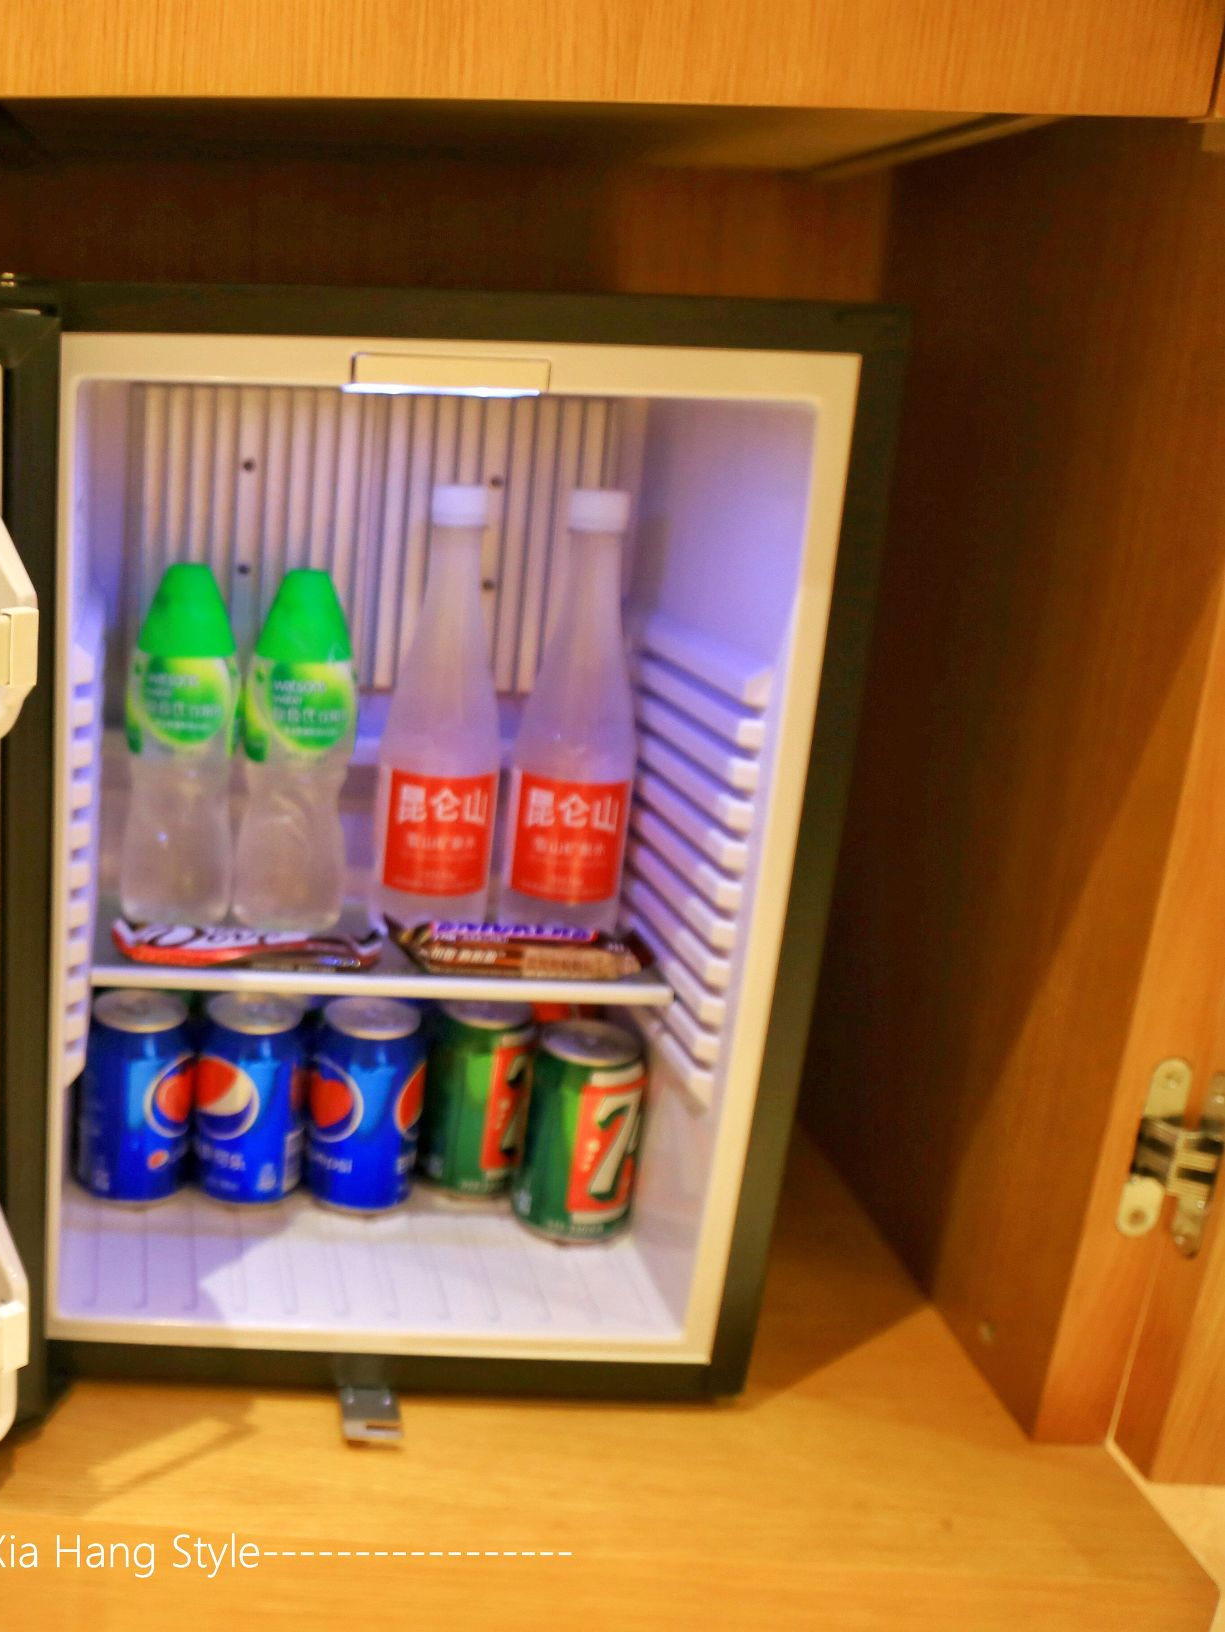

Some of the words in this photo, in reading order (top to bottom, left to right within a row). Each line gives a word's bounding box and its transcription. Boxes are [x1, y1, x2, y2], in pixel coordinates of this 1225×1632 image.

[398, 783, 488, 825] 昆仑山
[526, 787, 620, 833] 昆仑山
